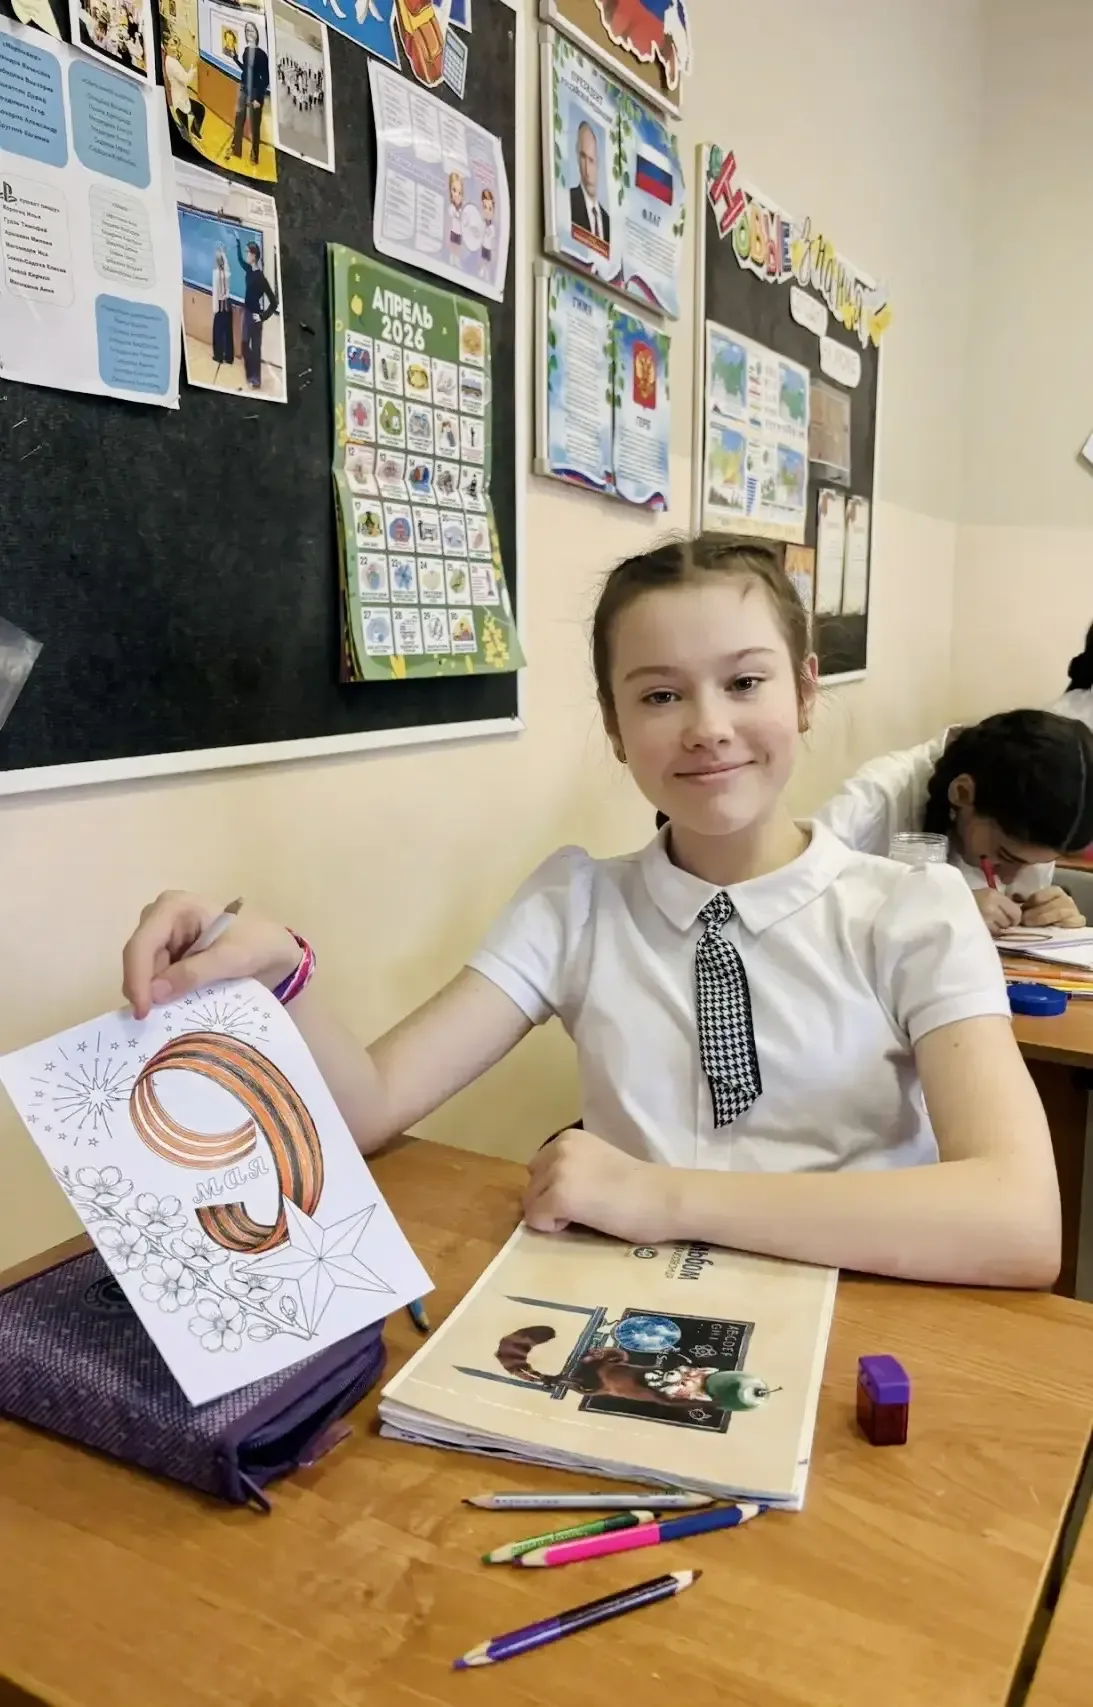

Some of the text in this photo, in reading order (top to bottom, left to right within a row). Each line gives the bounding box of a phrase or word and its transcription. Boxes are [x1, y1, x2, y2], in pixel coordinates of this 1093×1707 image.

[372, 286, 433, 330] АПРЕЛЬ
[381, 316, 425, 351] 2026
[360, 556, 368, 566] 22
[420, 561, 427, 570] 24
[363, 610, 371, 620] 27
[395, 610, 402, 620] 28
[677, 1245, 714, 1280] льбом
